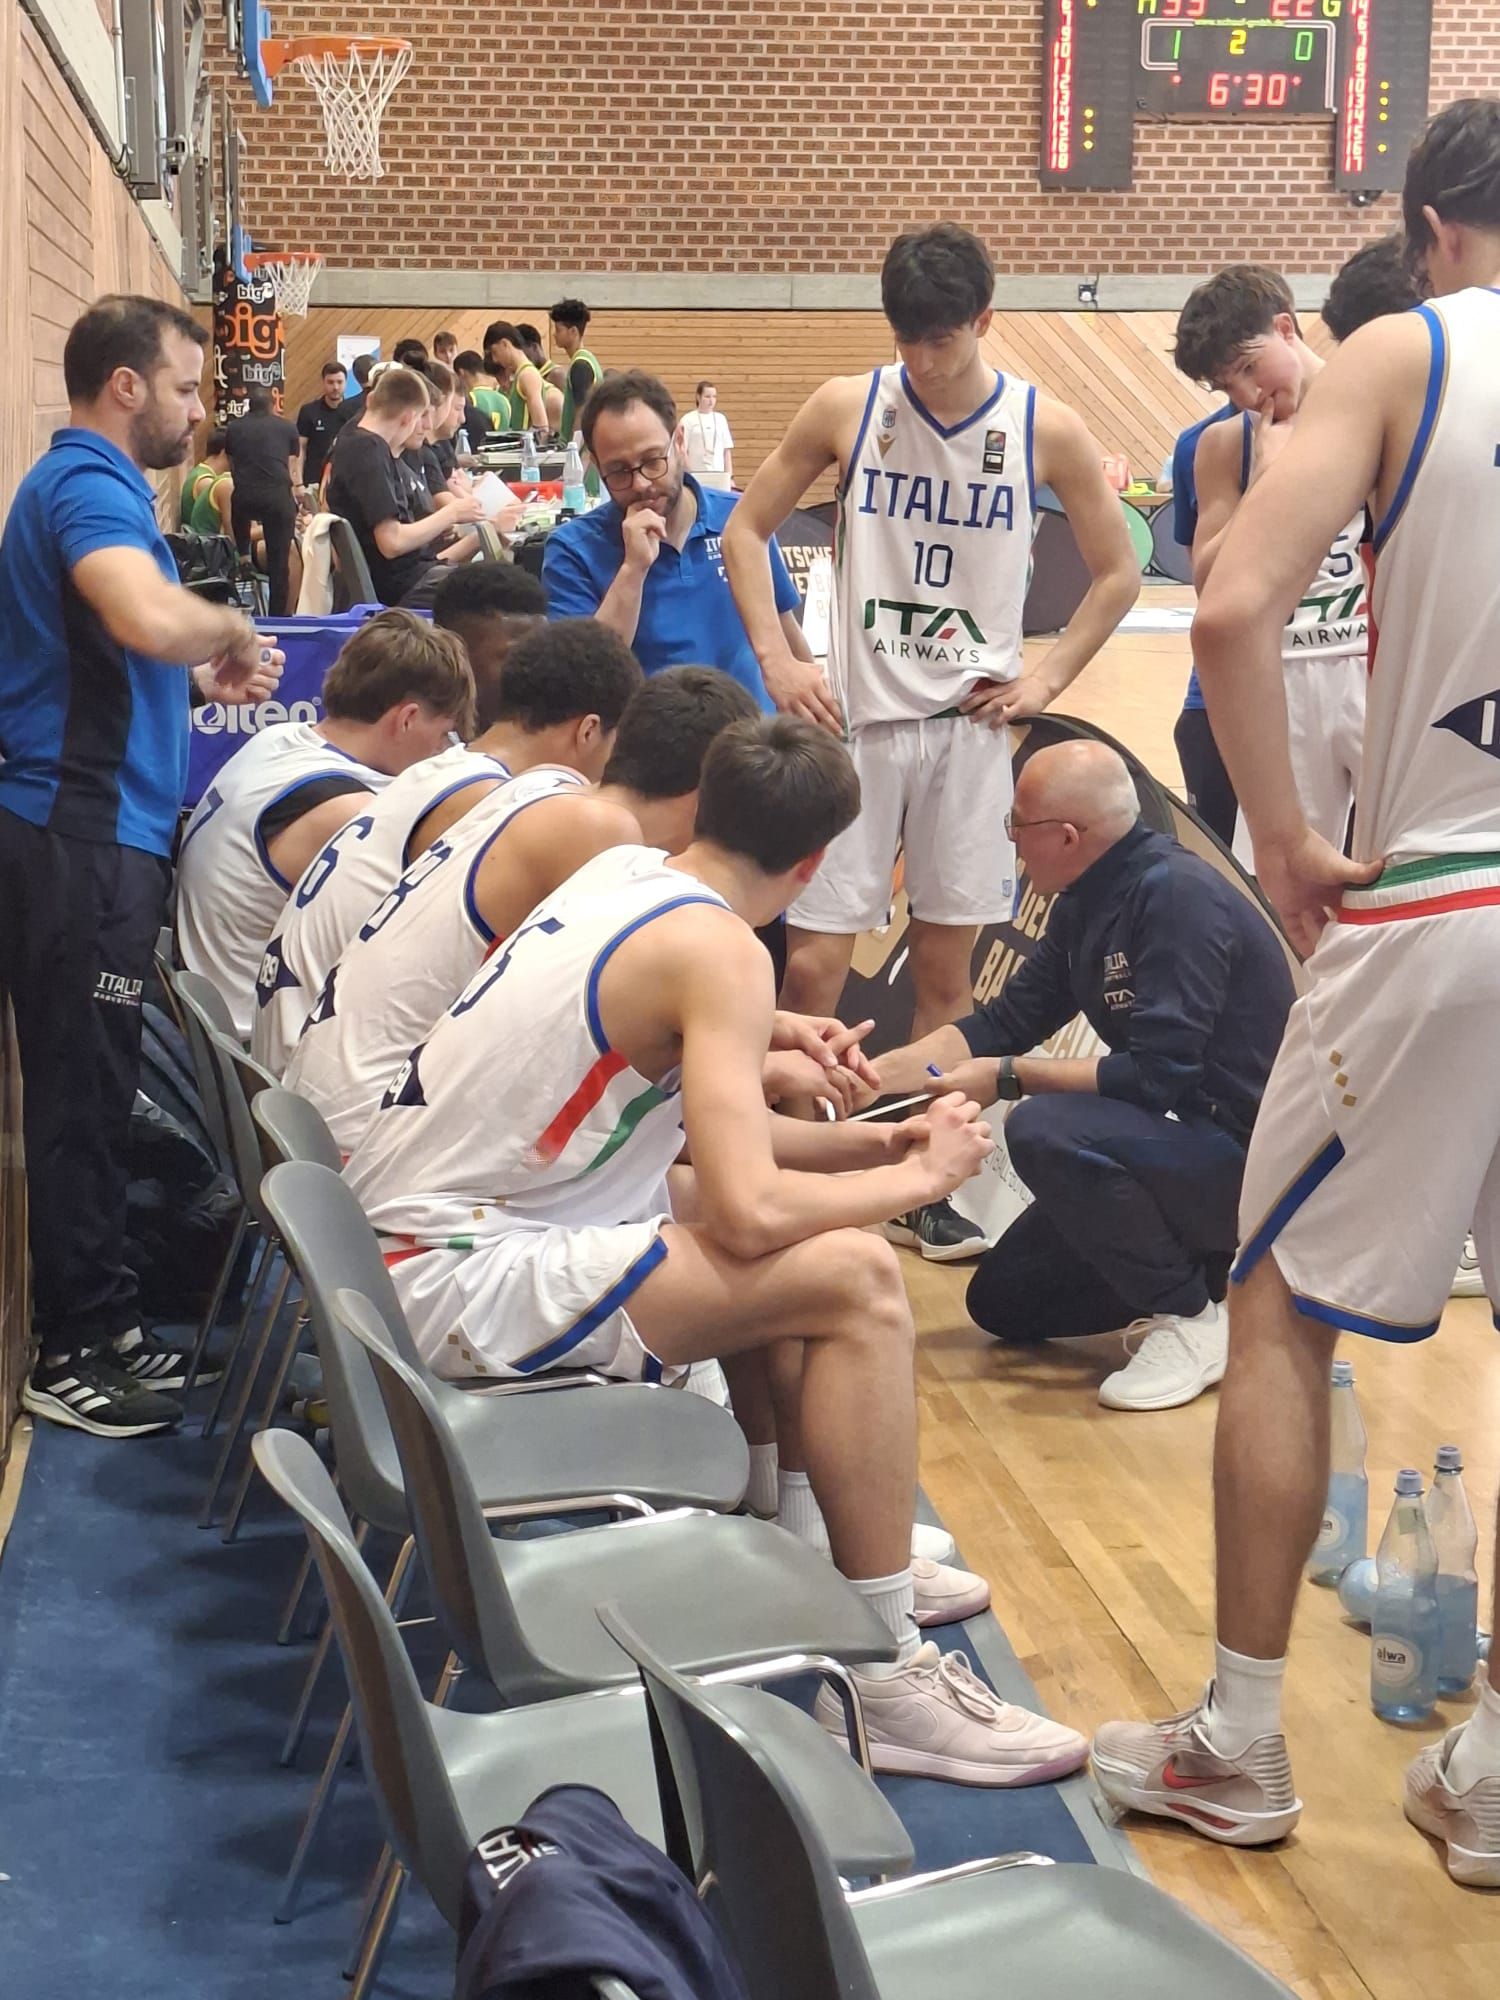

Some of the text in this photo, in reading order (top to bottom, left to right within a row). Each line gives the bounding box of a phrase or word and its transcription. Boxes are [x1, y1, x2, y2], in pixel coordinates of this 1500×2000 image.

[1173, 29, 1182, 60] 1
[1229, 29, 1248, 55] 2
[1294, 31, 1313, 61] 0
[237, 284, 264, 304] big
[858, 468, 1014, 531] ITALIA
[913, 541, 953, 588] 10
[864, 598, 988, 645] ITA
[1292, 623, 1367, 647] AIRWA
[873, 637, 980, 664] AIRWAYS
[188, 700, 318, 735] olten
